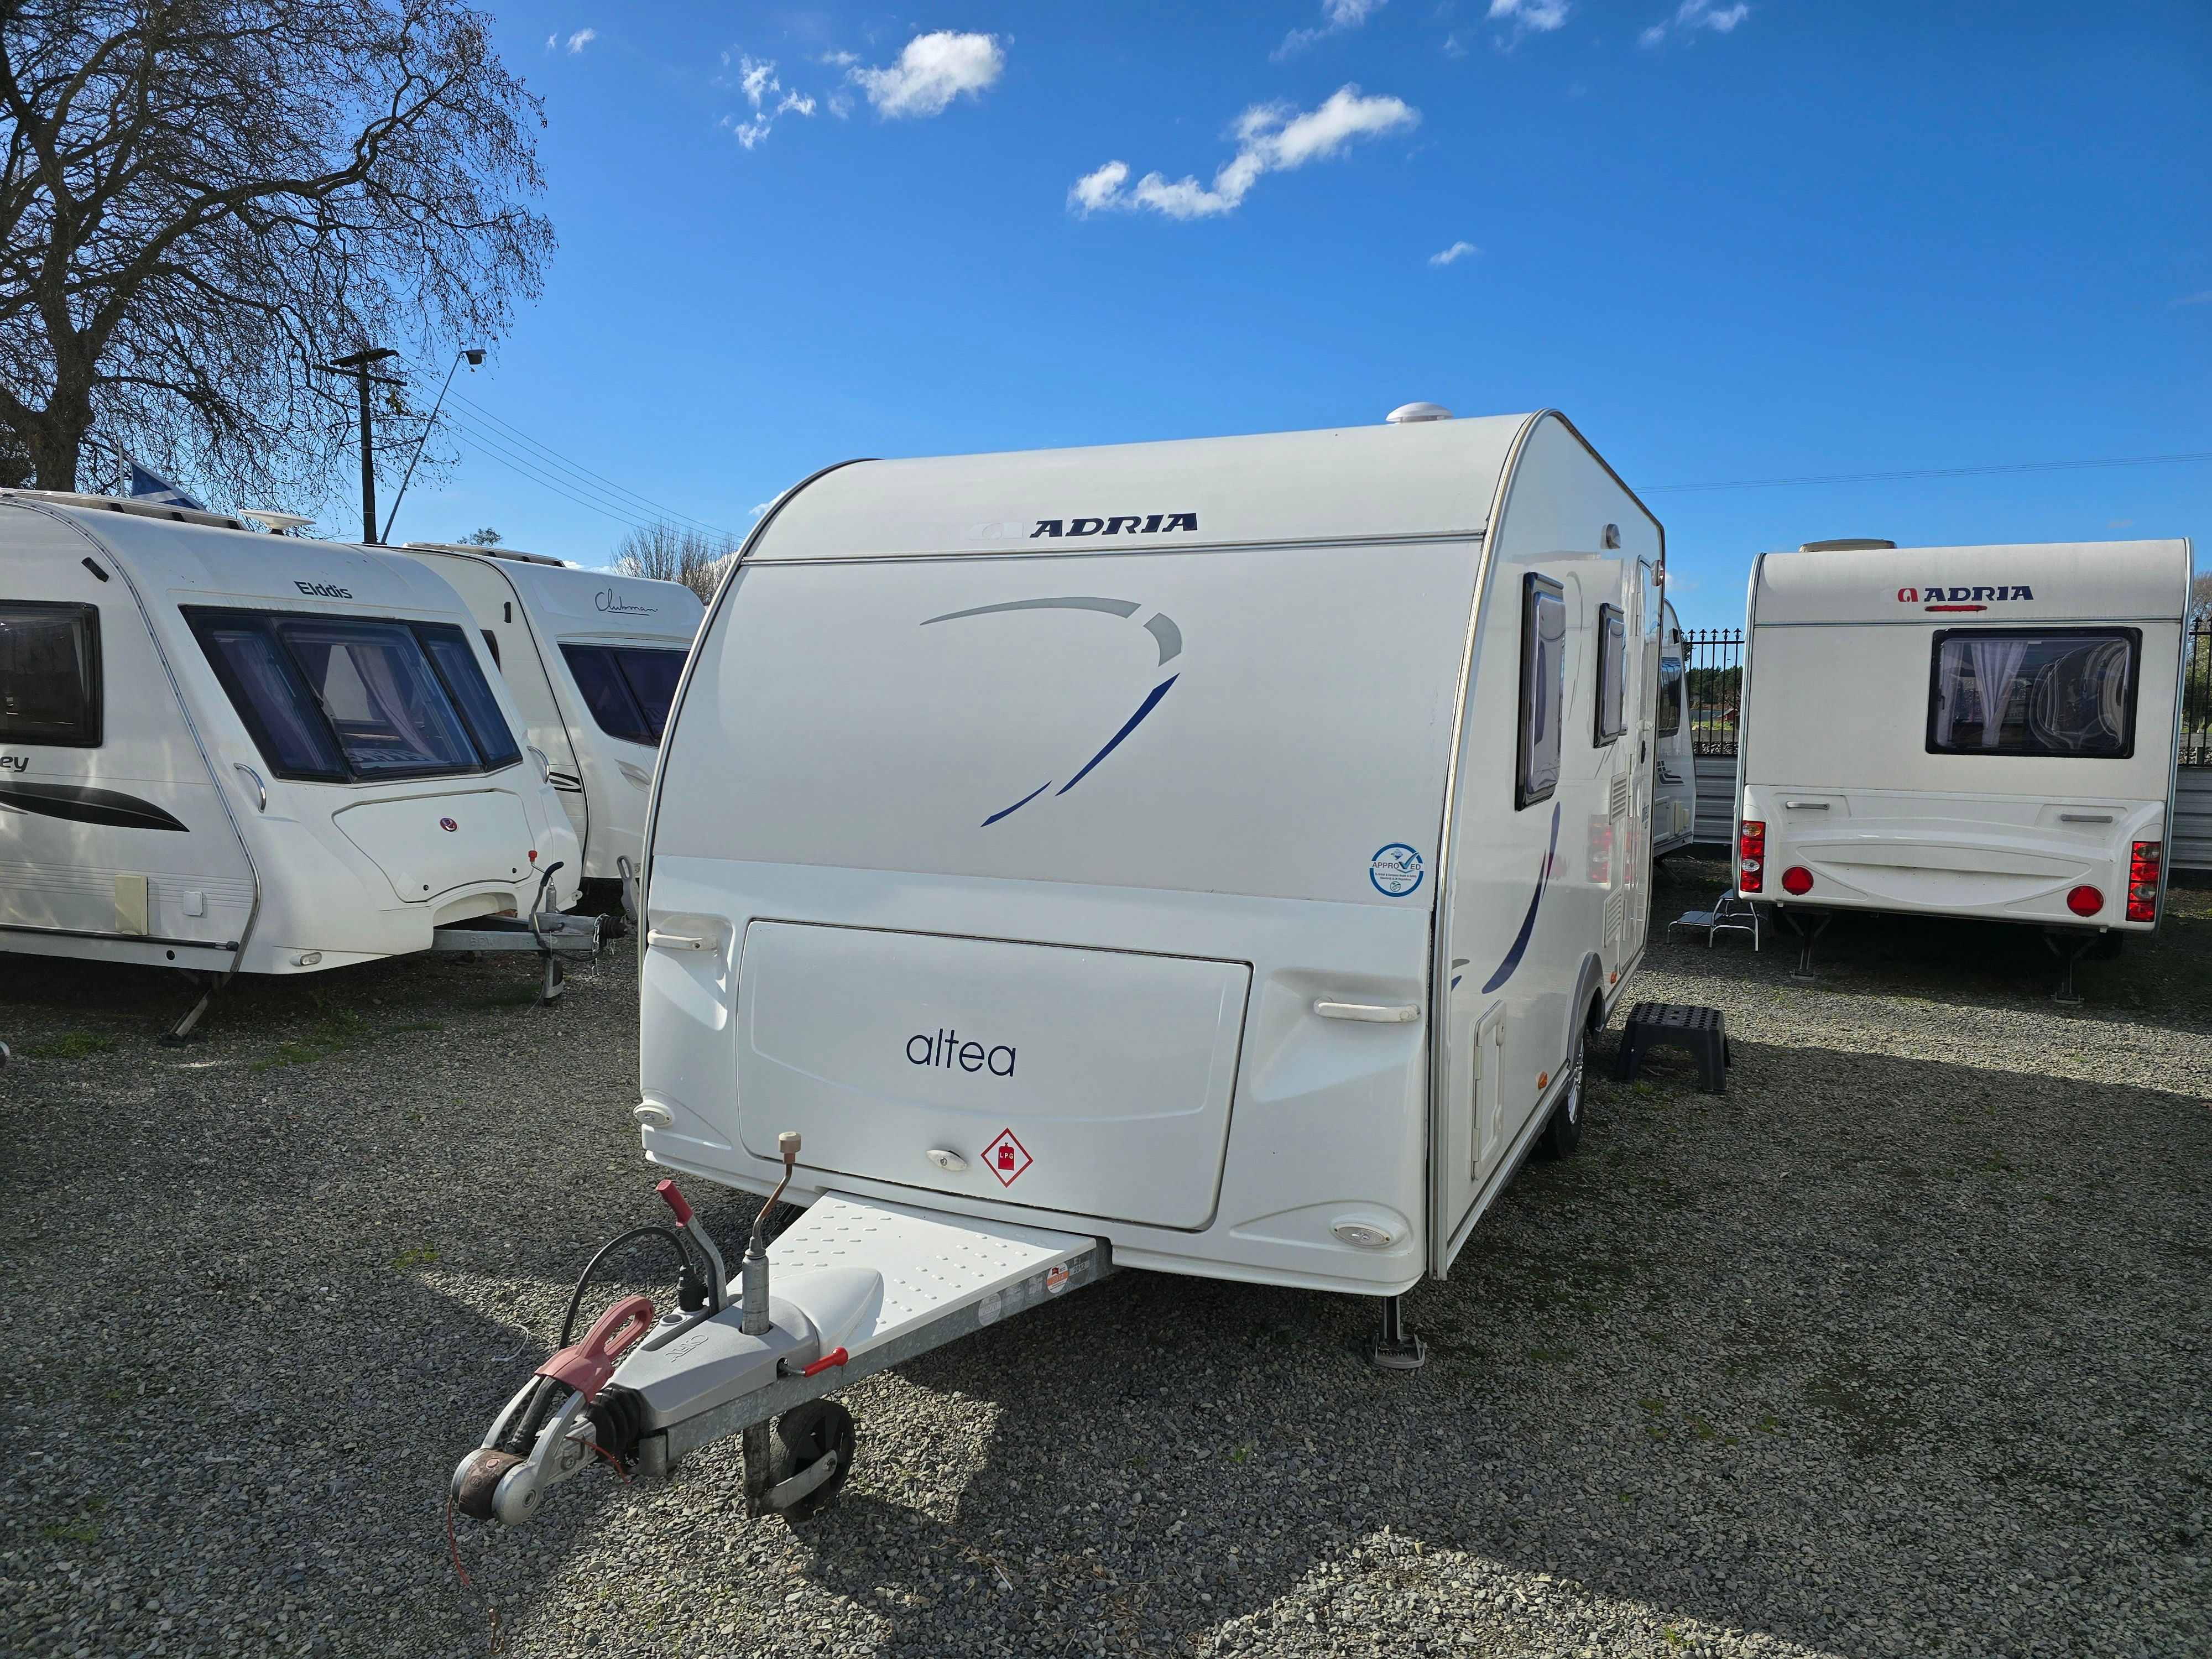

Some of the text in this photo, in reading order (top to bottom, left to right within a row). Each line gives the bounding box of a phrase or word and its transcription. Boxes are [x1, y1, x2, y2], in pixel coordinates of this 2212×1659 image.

[1029, 513, 1198, 538] ADRIA
[293, 581, 353, 599] Elddis
[1924, 586, 2034, 602] ADRIA
[906, 1028, 1016, 1077] altea
[1073, 1262, 1086, 1273] 2012
